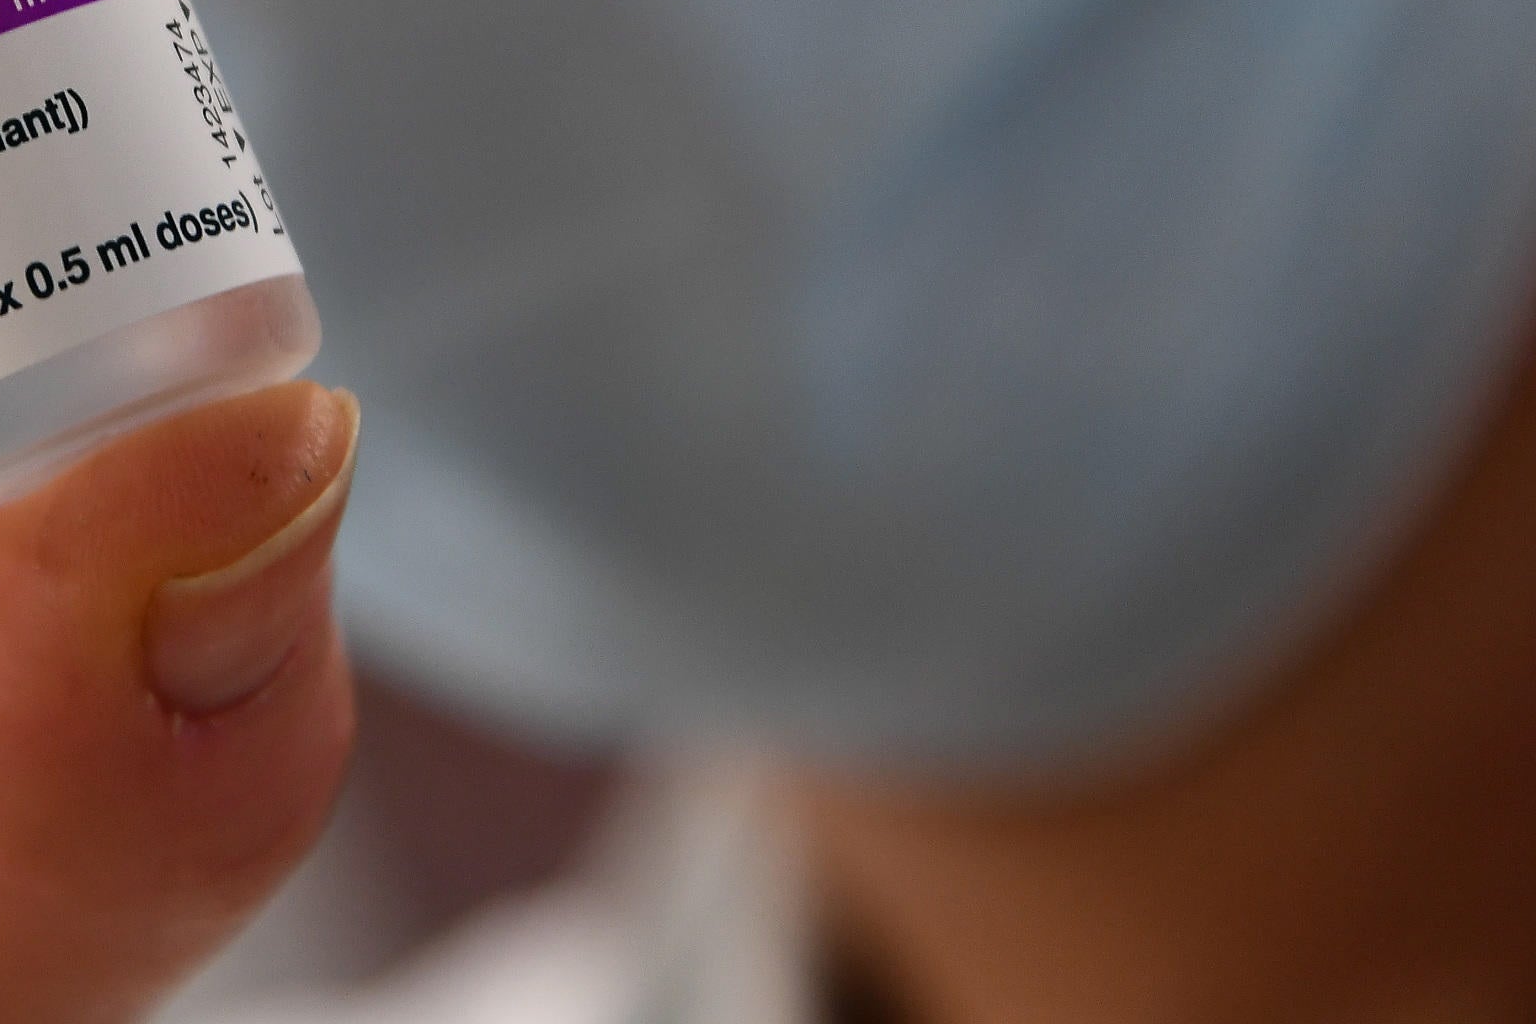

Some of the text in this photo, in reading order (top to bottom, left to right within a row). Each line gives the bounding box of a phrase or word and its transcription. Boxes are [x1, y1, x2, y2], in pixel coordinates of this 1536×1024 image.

[165, 18, 238, 170] 1423474
[190, 28, 234, 115] EXP
[24, 245, 92, 300] 0.5
[95, 221, 152, 274] ml
[156, 189, 260, 252] doses)
